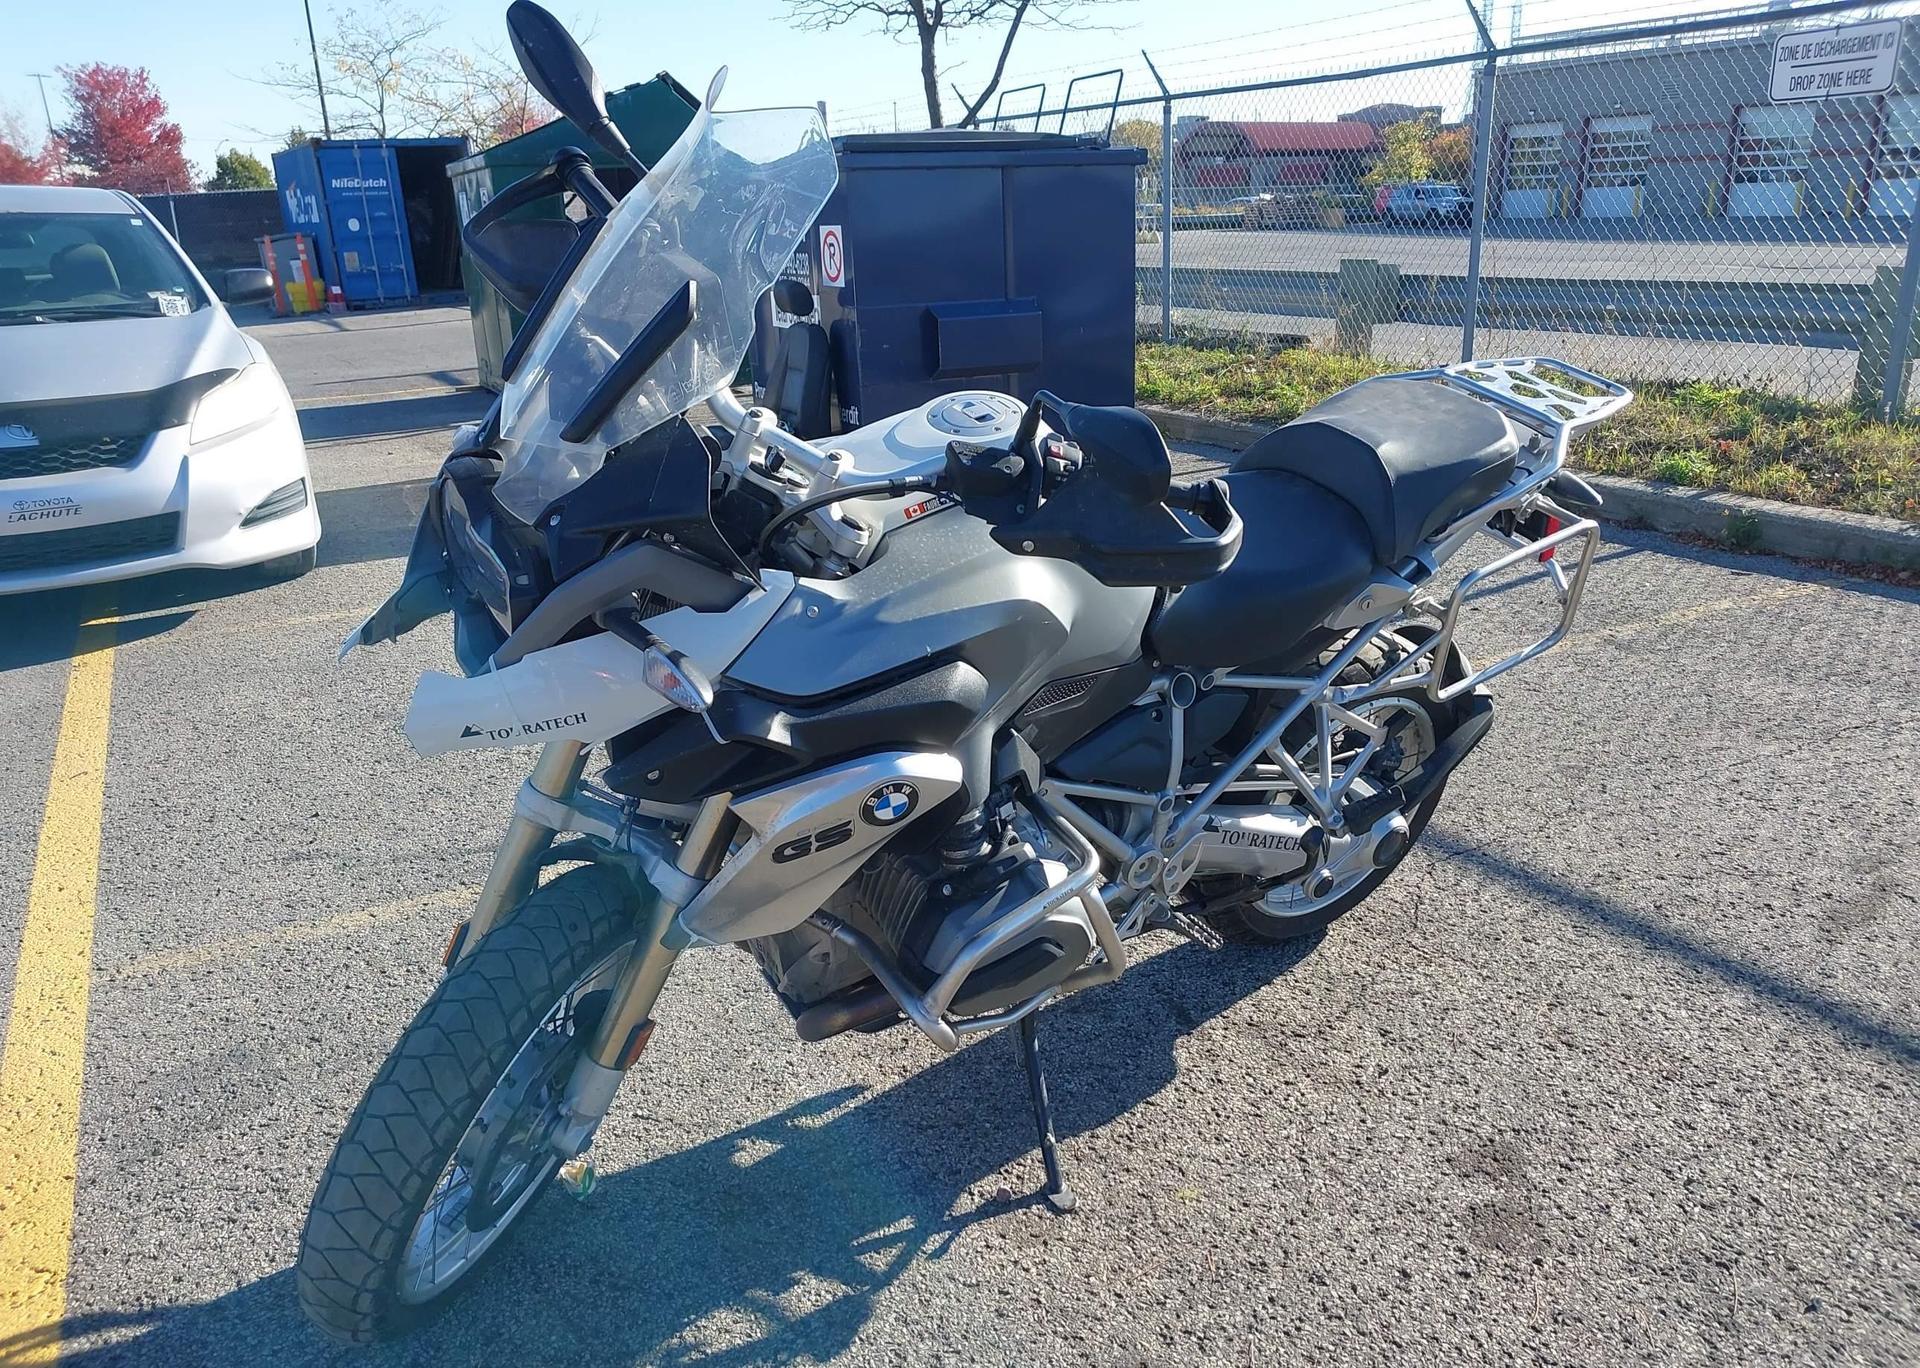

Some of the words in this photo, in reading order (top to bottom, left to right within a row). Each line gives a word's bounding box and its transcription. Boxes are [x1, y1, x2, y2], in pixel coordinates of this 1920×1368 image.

[1779, 45, 1800, 62] ZONE
[1801, 43, 1813, 59] DE
[1814, 34, 1883, 58] DÉCHARGEMENT
[1881, 32, 1896, 50] ICI
[1789, 74, 1816, 92] DROP
[1817, 71, 1844, 89] ZONE
[1845, 67, 1874, 87] HERE
[331, 177, 387, 188] NileDutch
[31, 496, 74, 508] TOYOTA
[8, 506, 83, 523] LACHUTE
[772, 819, 855, 864] GS
